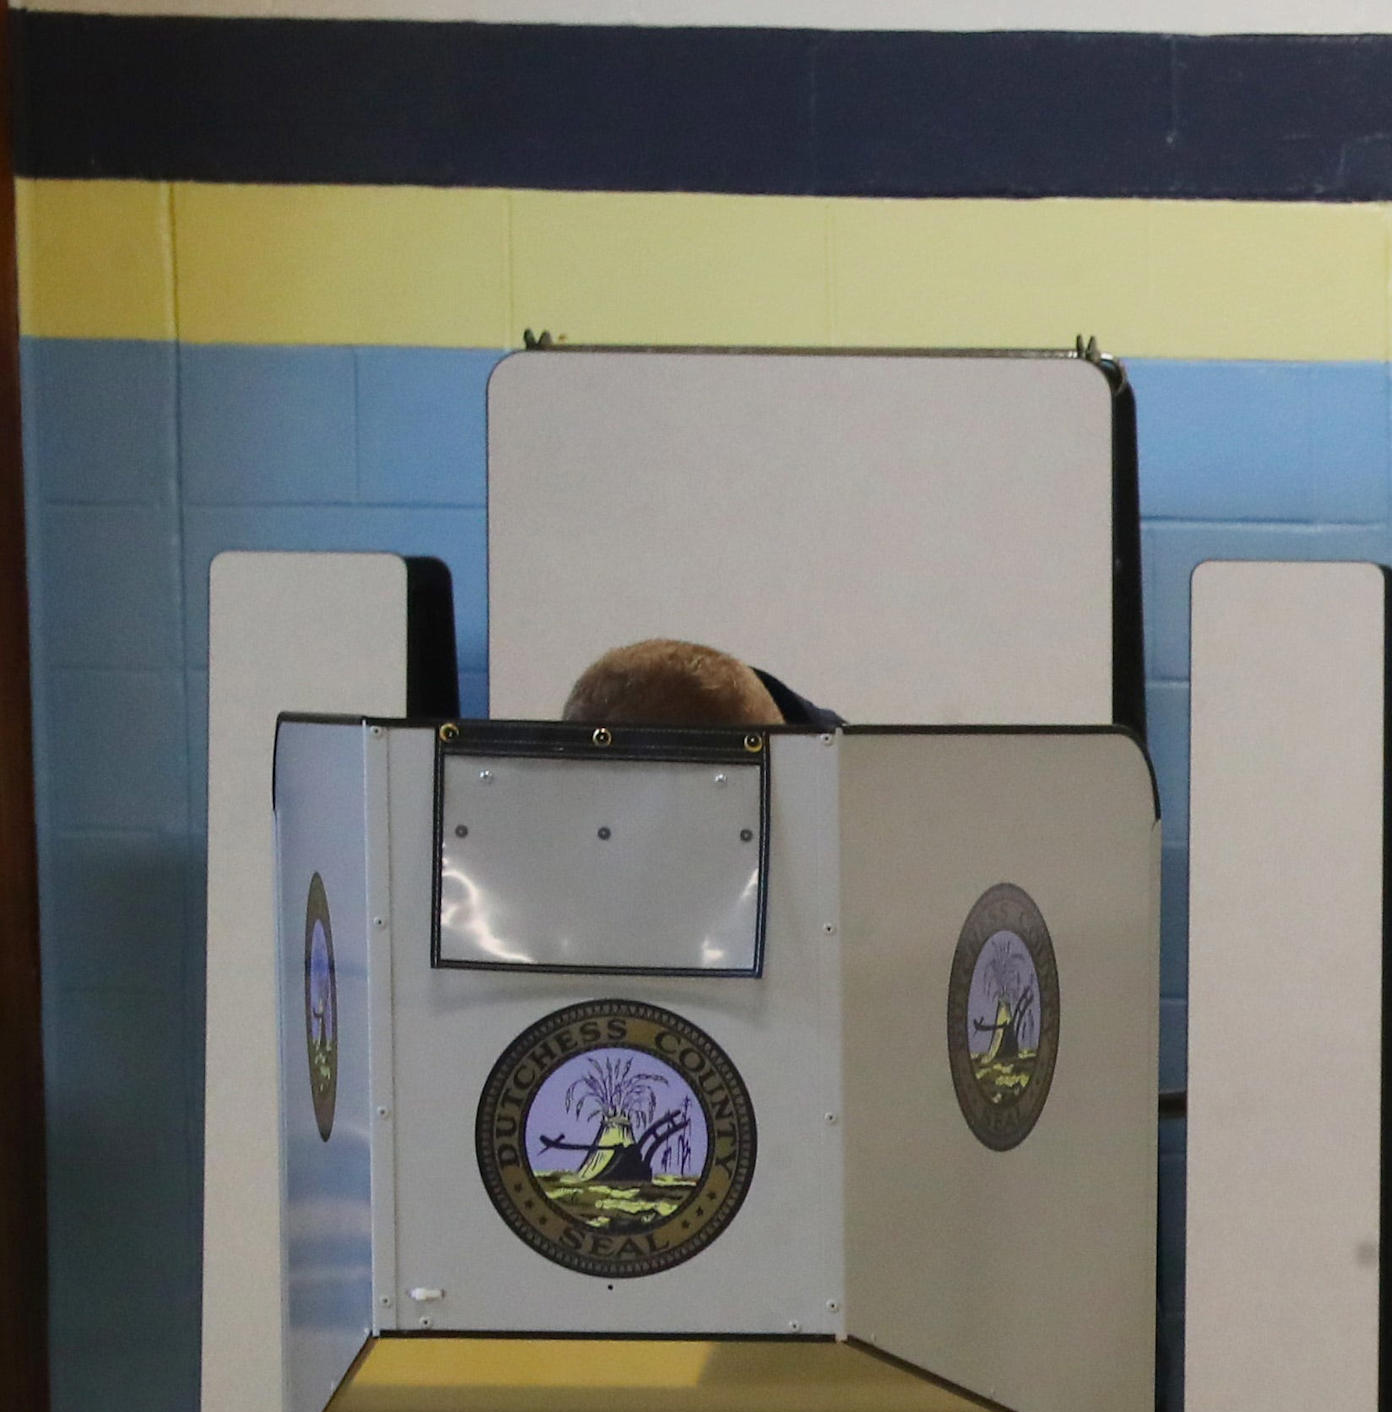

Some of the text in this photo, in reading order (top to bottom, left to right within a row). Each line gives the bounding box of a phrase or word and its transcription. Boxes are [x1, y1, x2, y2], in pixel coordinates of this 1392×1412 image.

[495, 1018, 738, 1179] DUTCHESS COUNTY
[559, 1225, 671, 1256] SEAL
